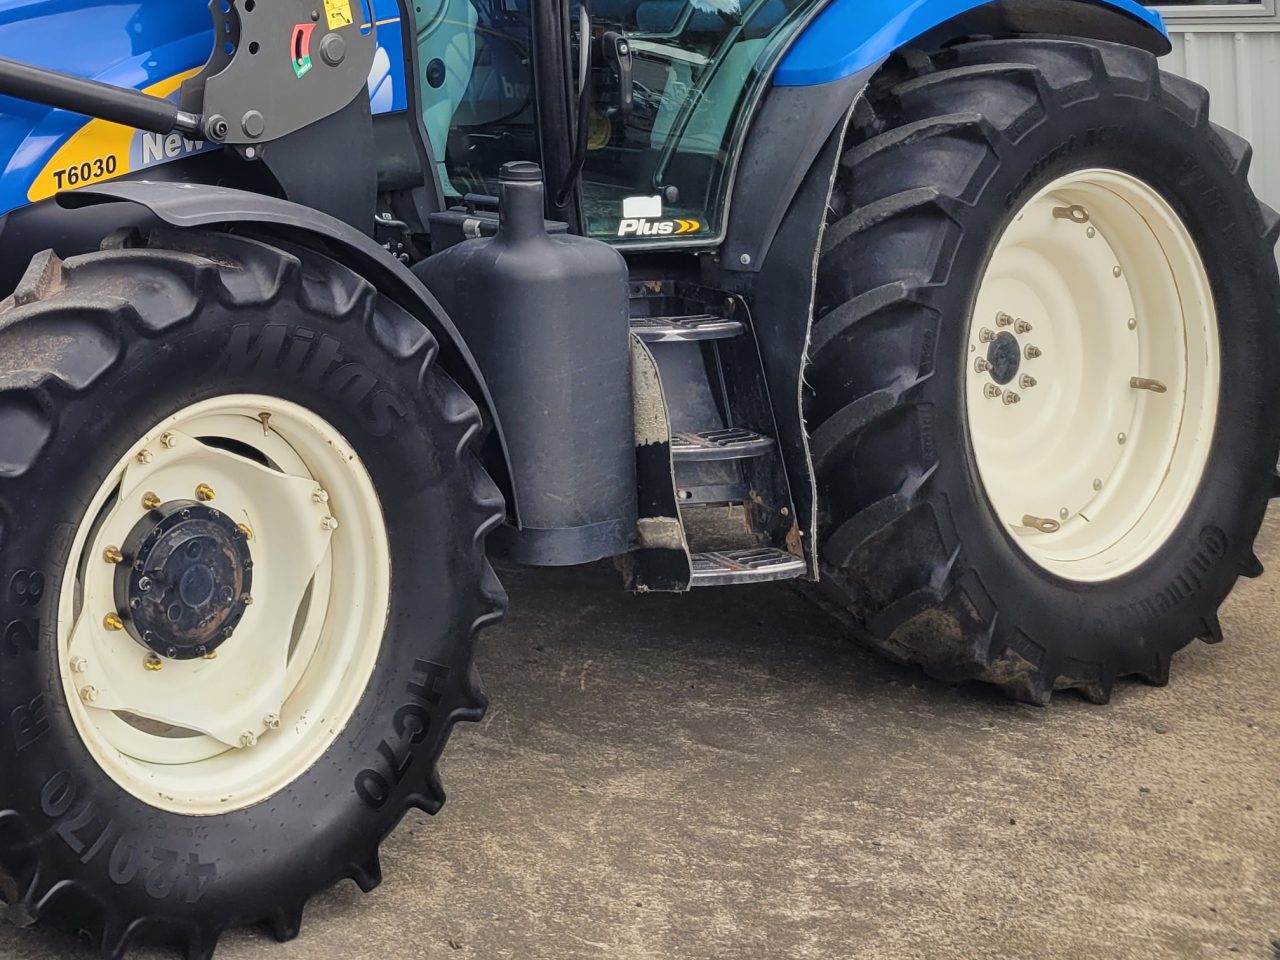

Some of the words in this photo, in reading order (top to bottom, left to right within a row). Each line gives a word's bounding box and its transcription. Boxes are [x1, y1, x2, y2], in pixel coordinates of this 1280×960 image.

[142, 131, 203, 165] New
[53, 155, 117, 189] T6030
[618, 219, 673, 236] Plus
[216, 322, 408, 437] Mitas
[354, 657, 451, 809] HC70
